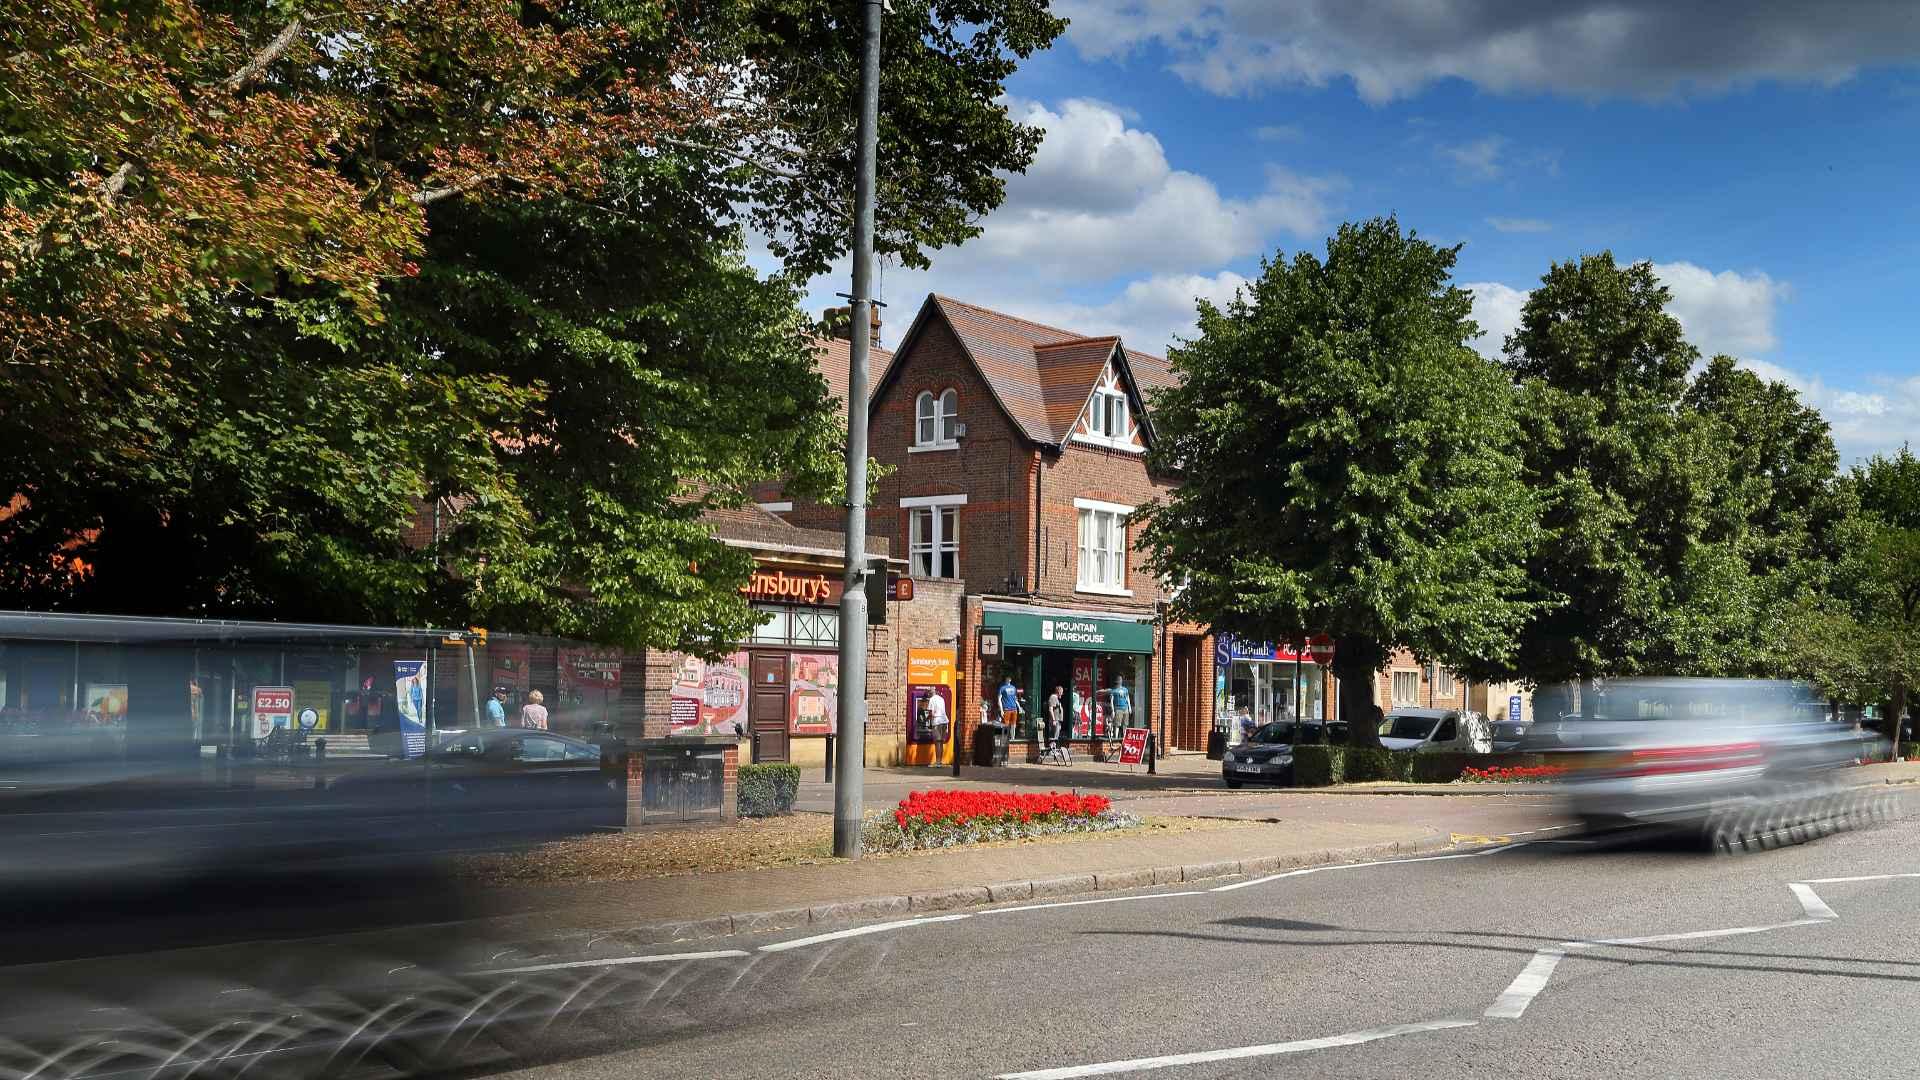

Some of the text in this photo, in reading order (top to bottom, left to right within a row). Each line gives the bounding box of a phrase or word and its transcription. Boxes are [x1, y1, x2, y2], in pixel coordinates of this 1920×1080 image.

[1055, 621, 1097, 633] MOUNTAIN
[1055, 632, 1105, 643] WAREHOUSE
[257, 698, 290, 709] £2.50
[1127, 732, 1145, 741] SALE
